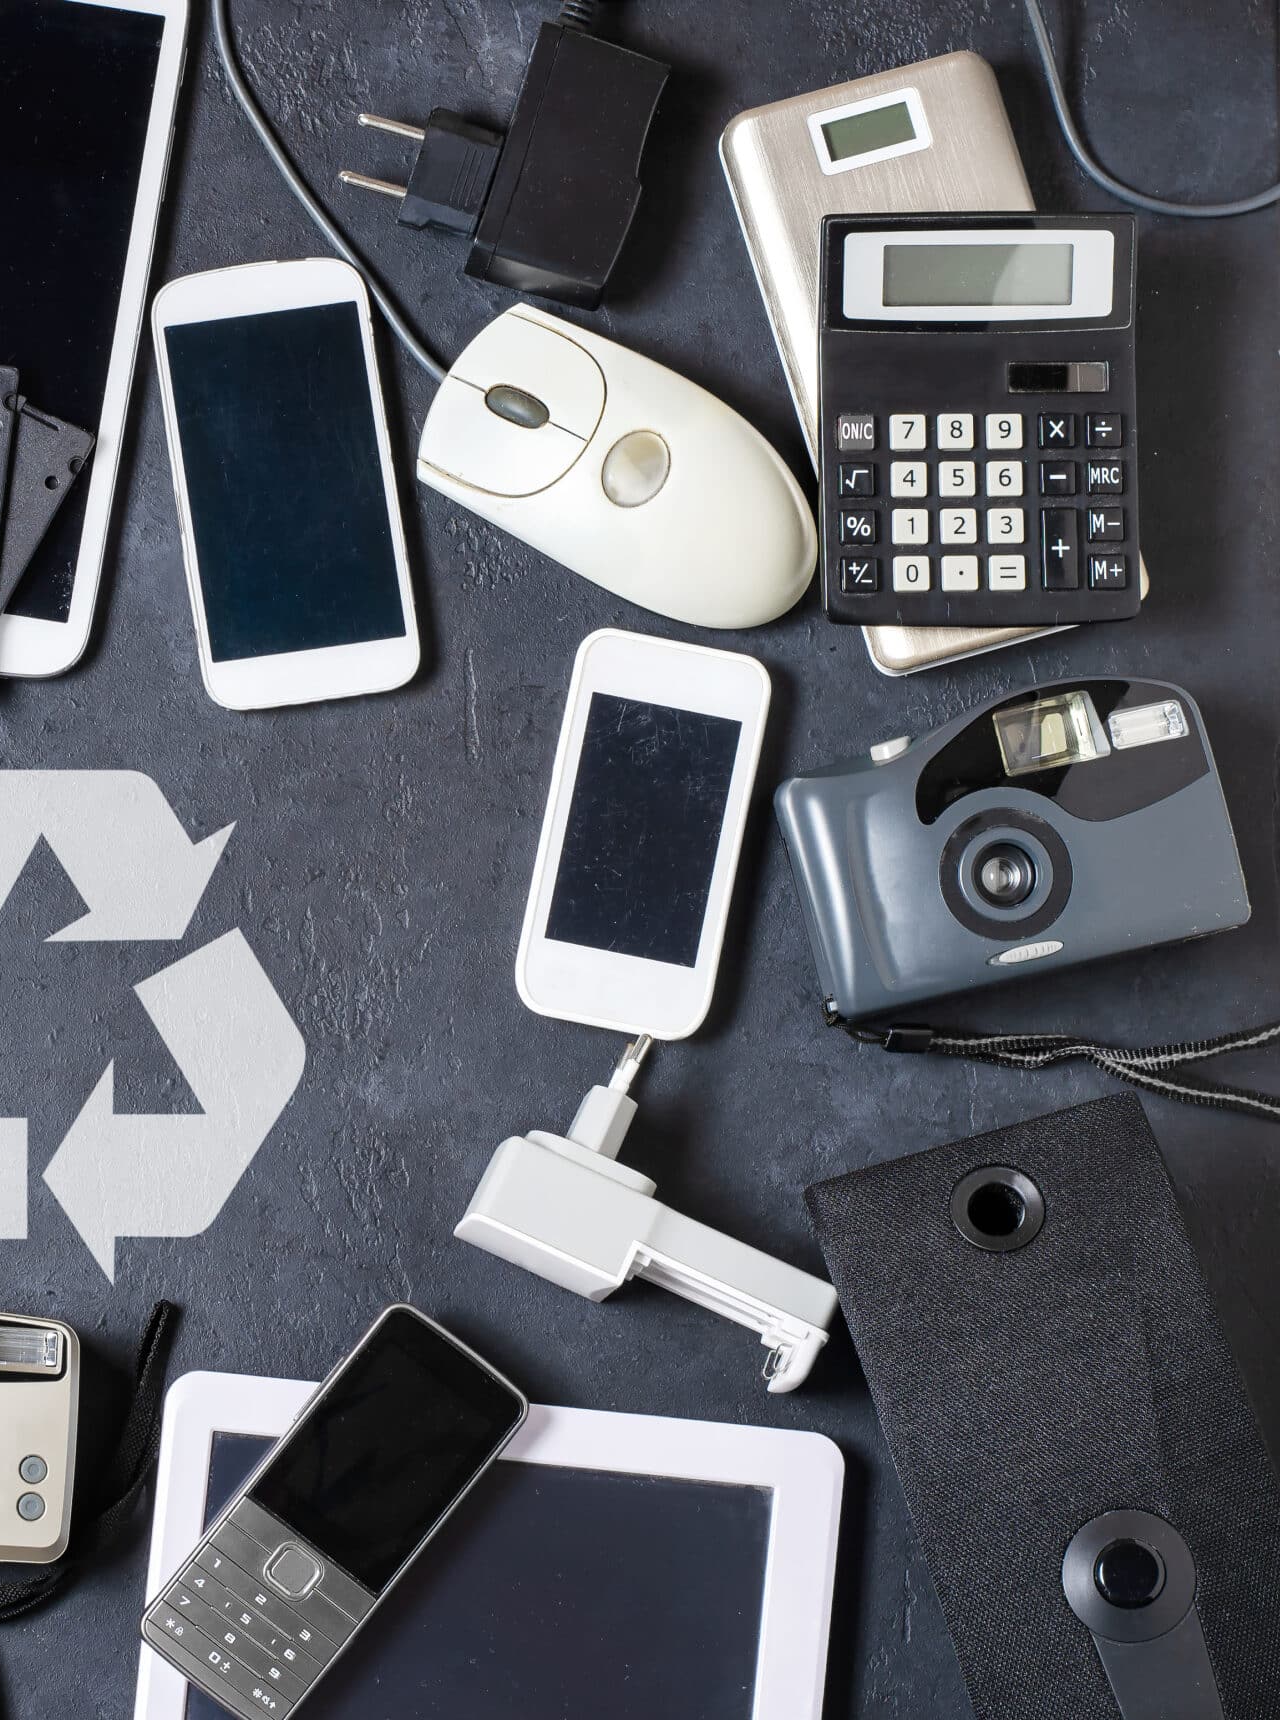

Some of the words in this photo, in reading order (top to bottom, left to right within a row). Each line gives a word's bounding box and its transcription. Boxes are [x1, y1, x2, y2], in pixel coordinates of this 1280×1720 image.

[841, 423, 873, 440] ON/C
[902, 421, 915, 439] 7
[950, 420, 963, 439] 8
[998, 420, 1012, 439] 9
[902, 469, 916, 487] 4
[952, 468, 965, 487] 5
[998, 468, 1012, 487] 6
[1090, 467, 1120, 484] MRC
[846, 516, 871, 537] %
[908, 517, 915, 535] 1
[953, 516, 967, 535] 2
[1000, 515, 1013, 534] 3
[1051, 538, 1070, 558] +
[906, 564, 919, 583] 0
[1000, 566, 1017, 579] =
[1094, 560, 1123, 580] M+
[213, 1558, 222, 1568] 1
[194, 1578, 206, 1588] 4
[179, 1595, 191, 1606] 7
[254, 1593, 267, 1606] 2
[239, 1612, 252, 1625] 5
[224, 1632, 236, 1644] 8
[298, 1628, 311, 1642] 3
[208, 1651, 221, 1664] 0
[283, 1648, 297, 1661] 6
[268, 1667, 281, 1680] 9
